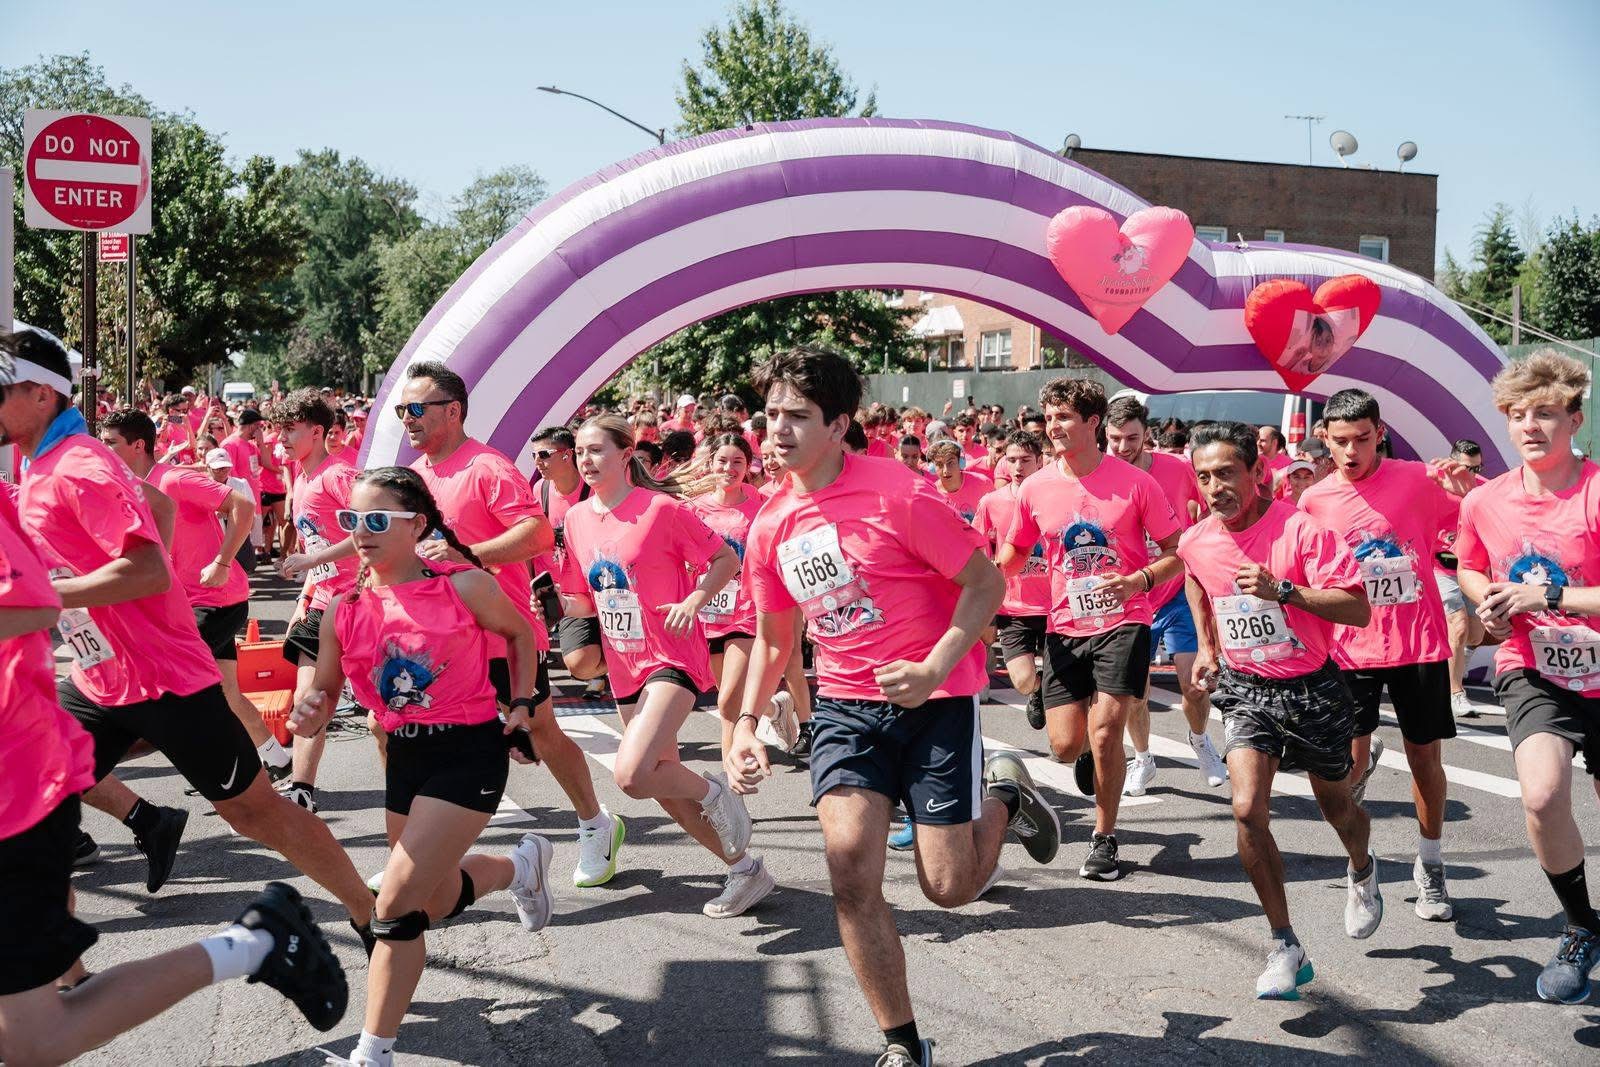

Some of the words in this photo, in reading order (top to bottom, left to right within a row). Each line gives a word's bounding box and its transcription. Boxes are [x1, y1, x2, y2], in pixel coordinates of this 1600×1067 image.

[45, 135, 75, 154] DO
[89, 138, 131, 158] NOT
[54, 187, 123, 208] ENTER
[794, 552, 839, 590] 1568
[1073, 552, 1104, 573] 5K
[601, 611, 633, 632] 2727
[1227, 614, 1276, 640] 3266
[68, 629, 101, 659] 176
[1543, 646, 1597, 669] 2621
